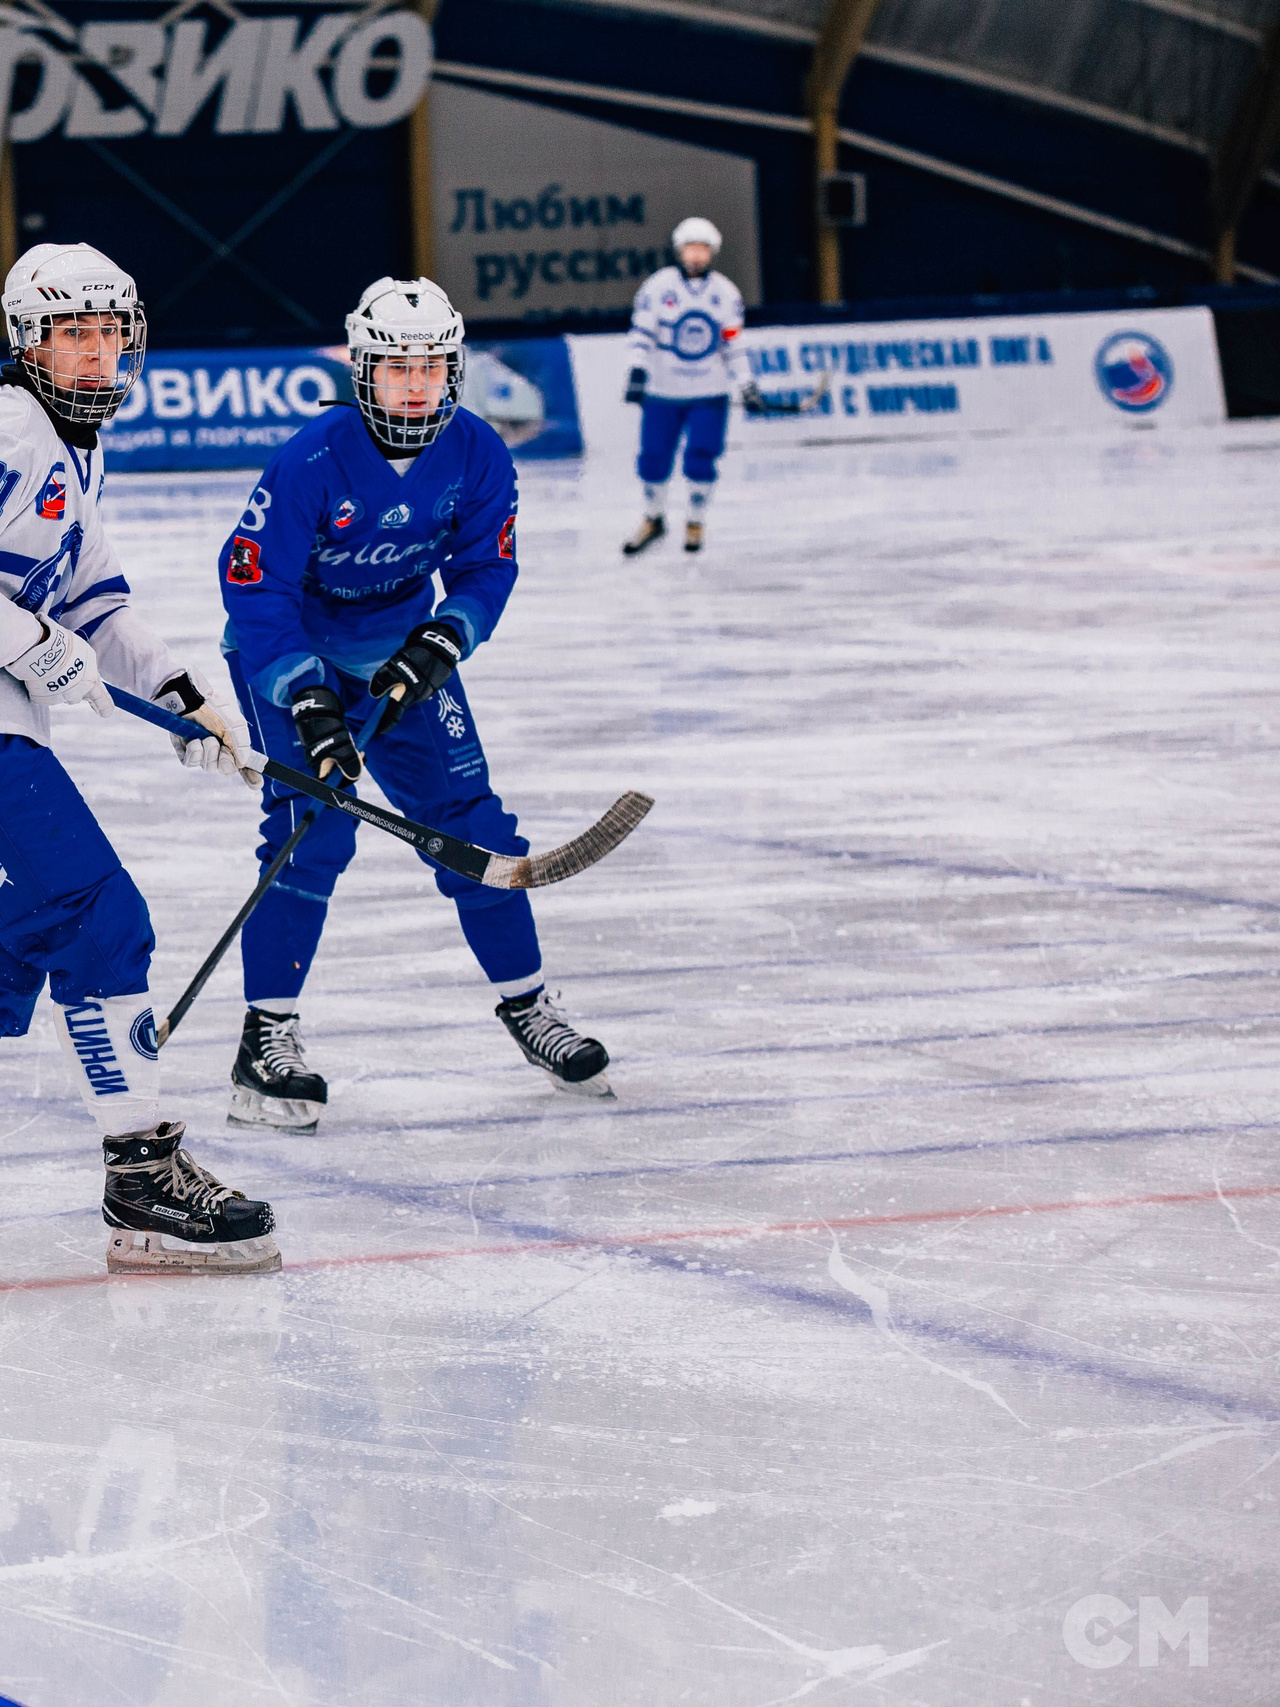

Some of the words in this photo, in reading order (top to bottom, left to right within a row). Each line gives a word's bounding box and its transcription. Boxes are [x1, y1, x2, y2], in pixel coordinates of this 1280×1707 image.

[450, 182, 646, 235] Любим
[82, 284, 115, 292] CCM
[474, 247, 678, 301] русски
[7, 299, 22, 307] CCM
[400, 332, 435, 341] Reebok
[422, 631, 461, 661] COBR
[47, 658, 84, 692] 8088
[64, 1001, 129, 1096] ИРНИТУ
[154, 1206, 186, 1219] BAUER
